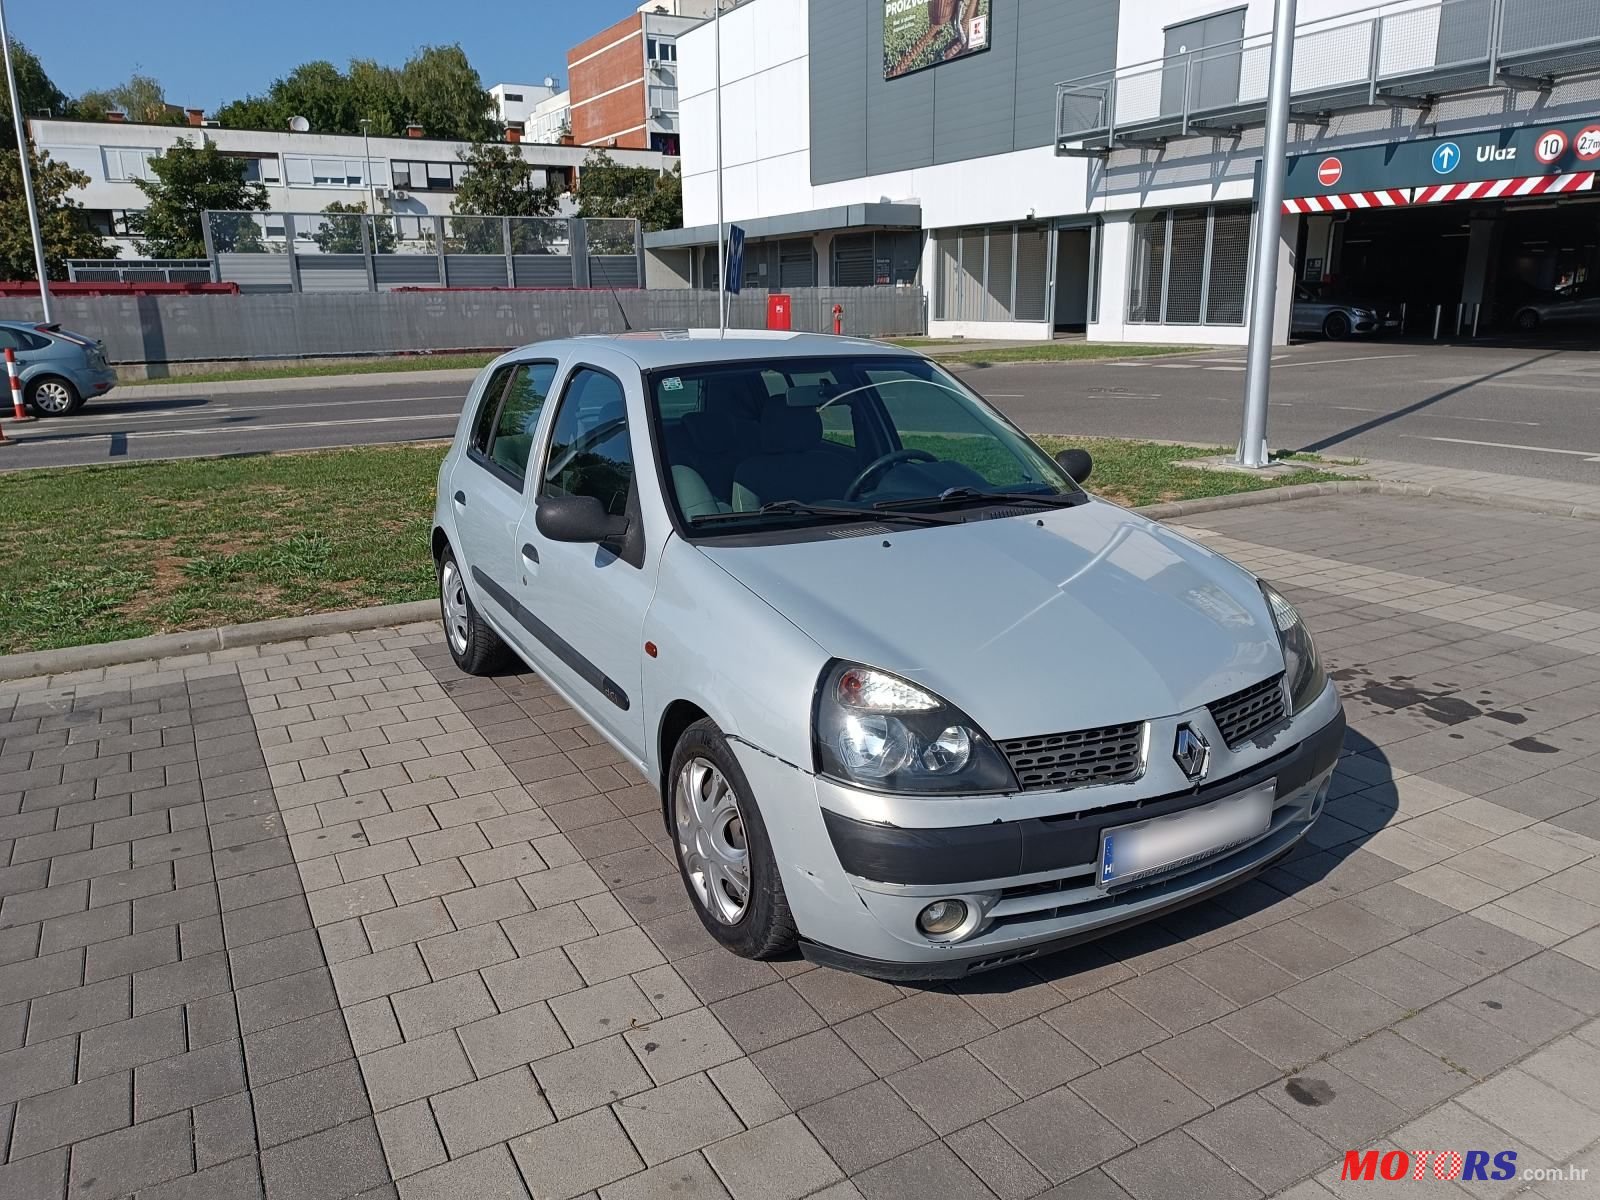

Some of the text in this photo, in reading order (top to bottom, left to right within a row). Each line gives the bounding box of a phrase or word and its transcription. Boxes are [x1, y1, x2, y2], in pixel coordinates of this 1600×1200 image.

[885, 0, 929, 17] PROIZV
[1476, 144, 1517, 162] Ulaz
[1543, 138, 1560, 156] 10
